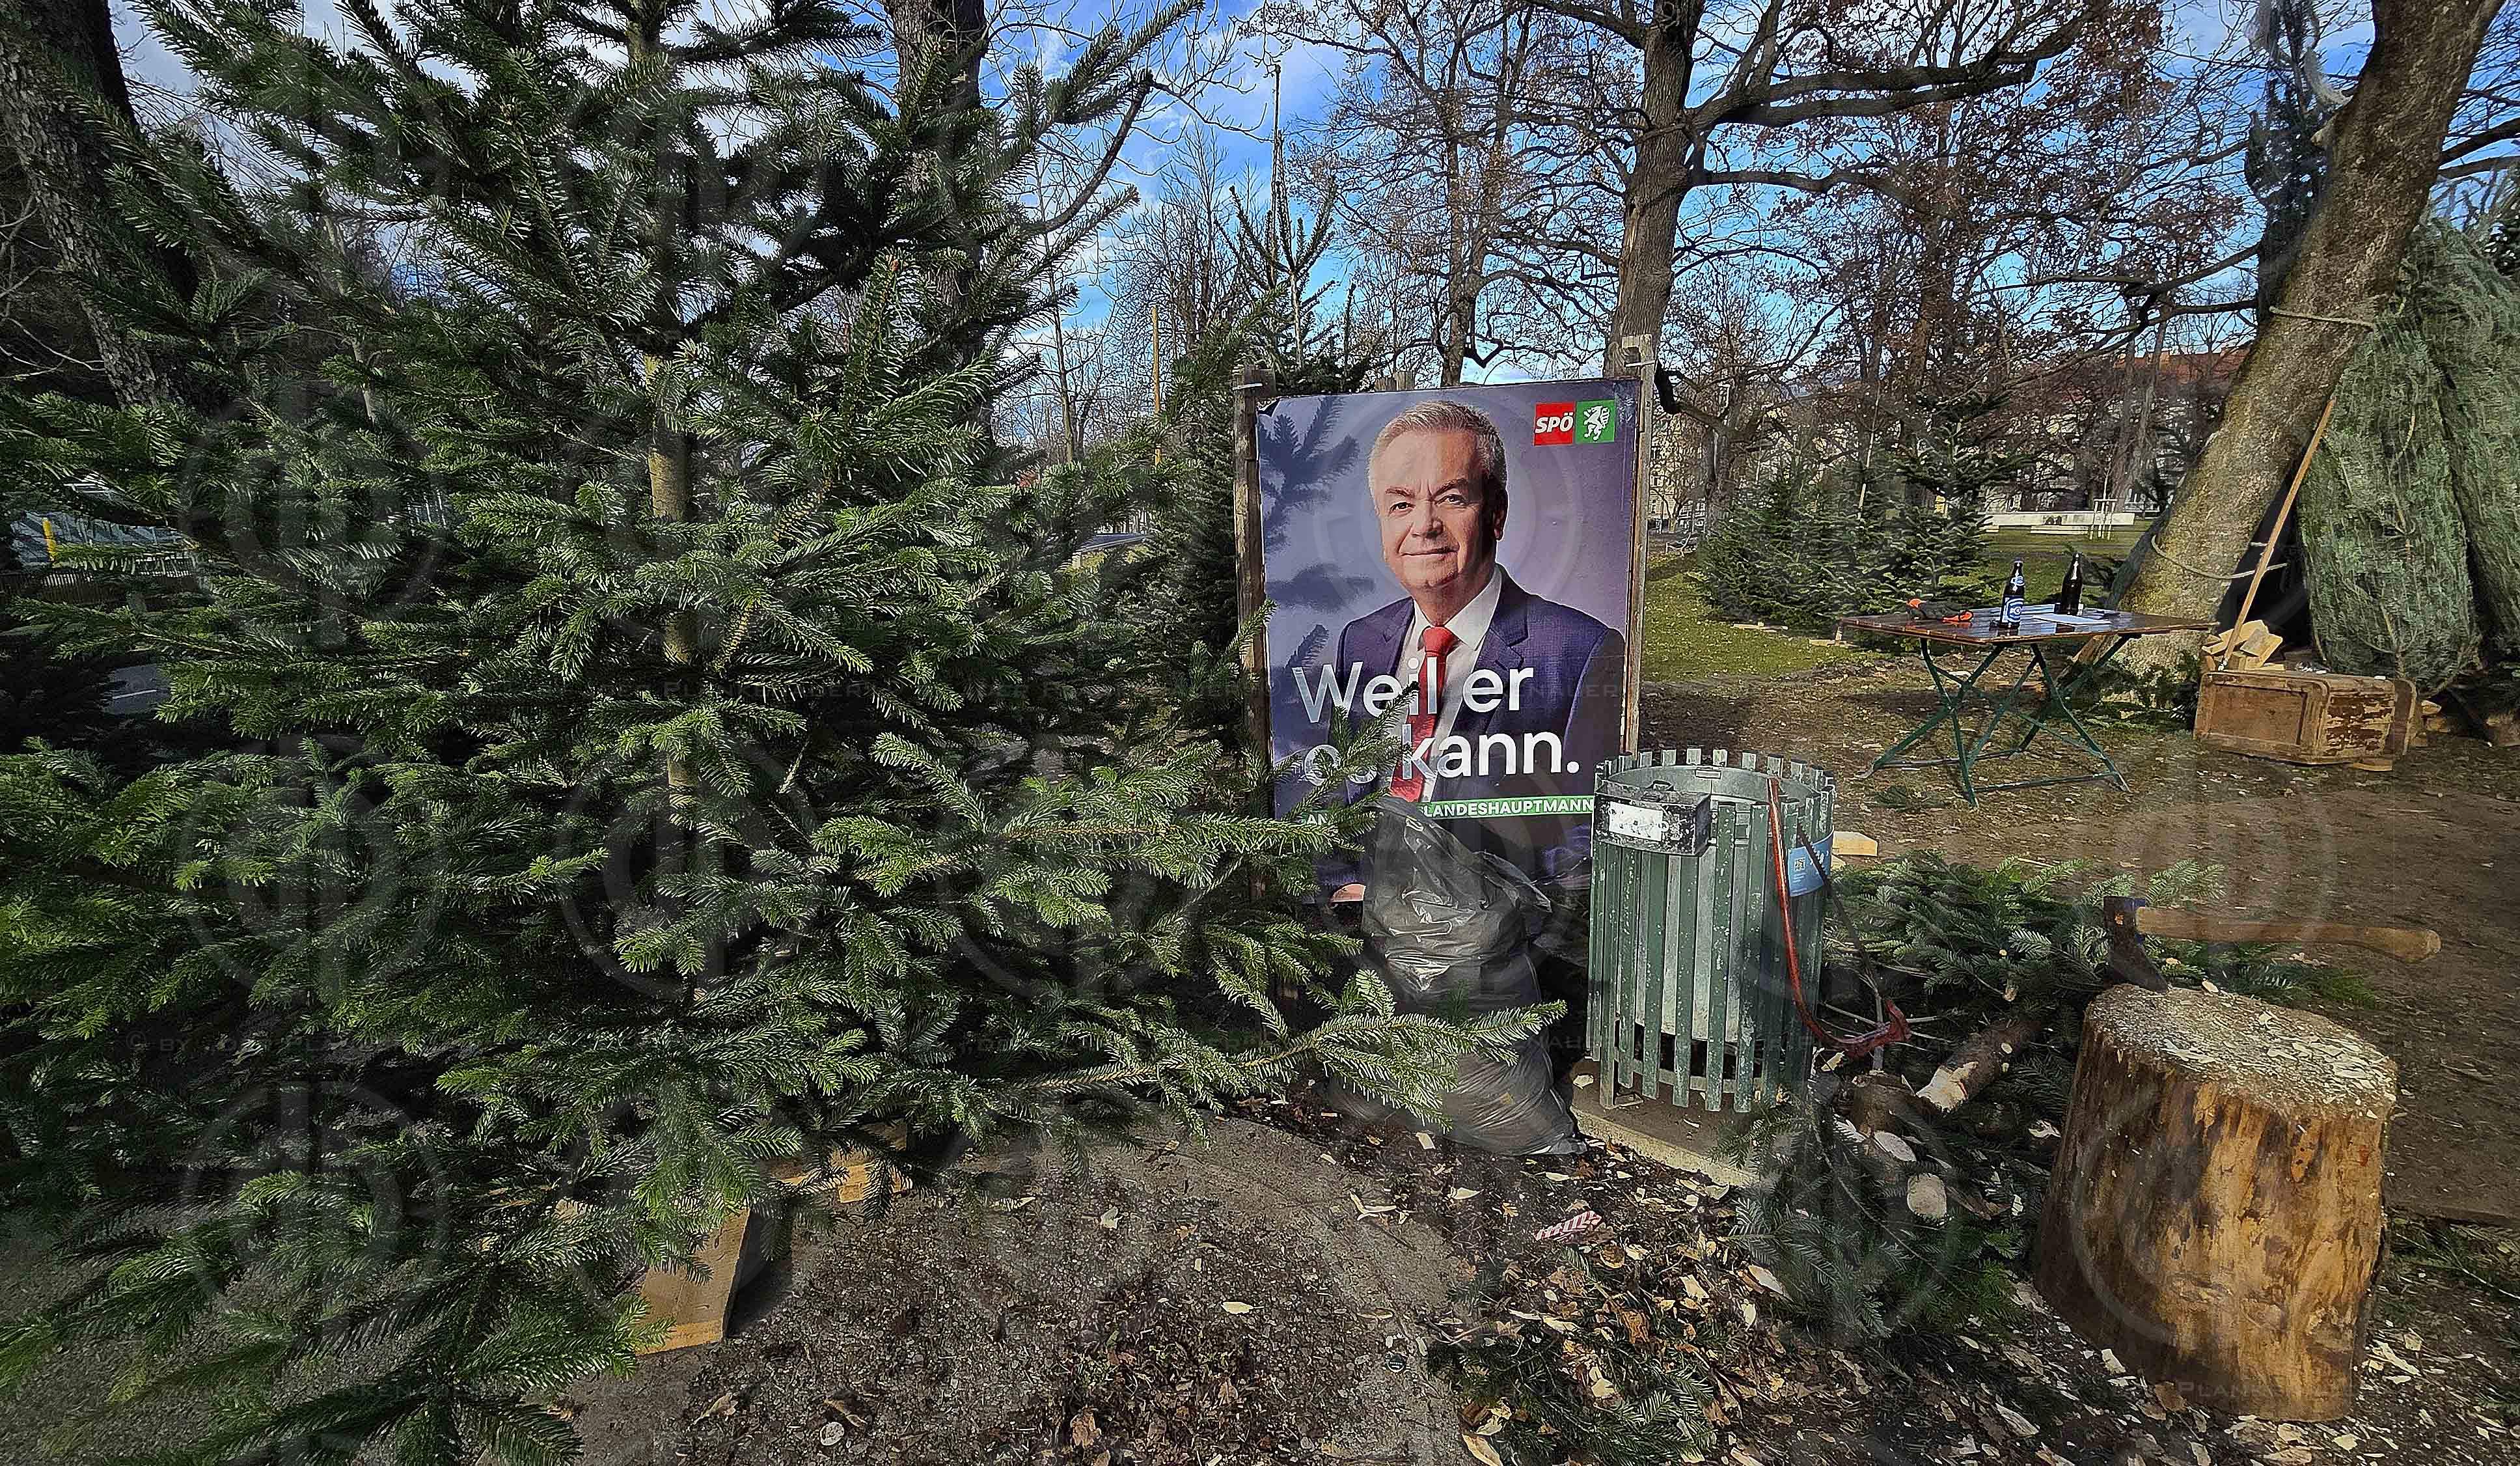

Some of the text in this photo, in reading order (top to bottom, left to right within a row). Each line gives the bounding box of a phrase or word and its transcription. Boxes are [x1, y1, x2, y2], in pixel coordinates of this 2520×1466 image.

[1535, 412, 1574, 433] SPÖ
[1292, 657, 1534, 723] Weil er
[1401, 724, 1580, 780] kann.
[1423, 798, 1593, 817] LANDESHAUPTMANN
